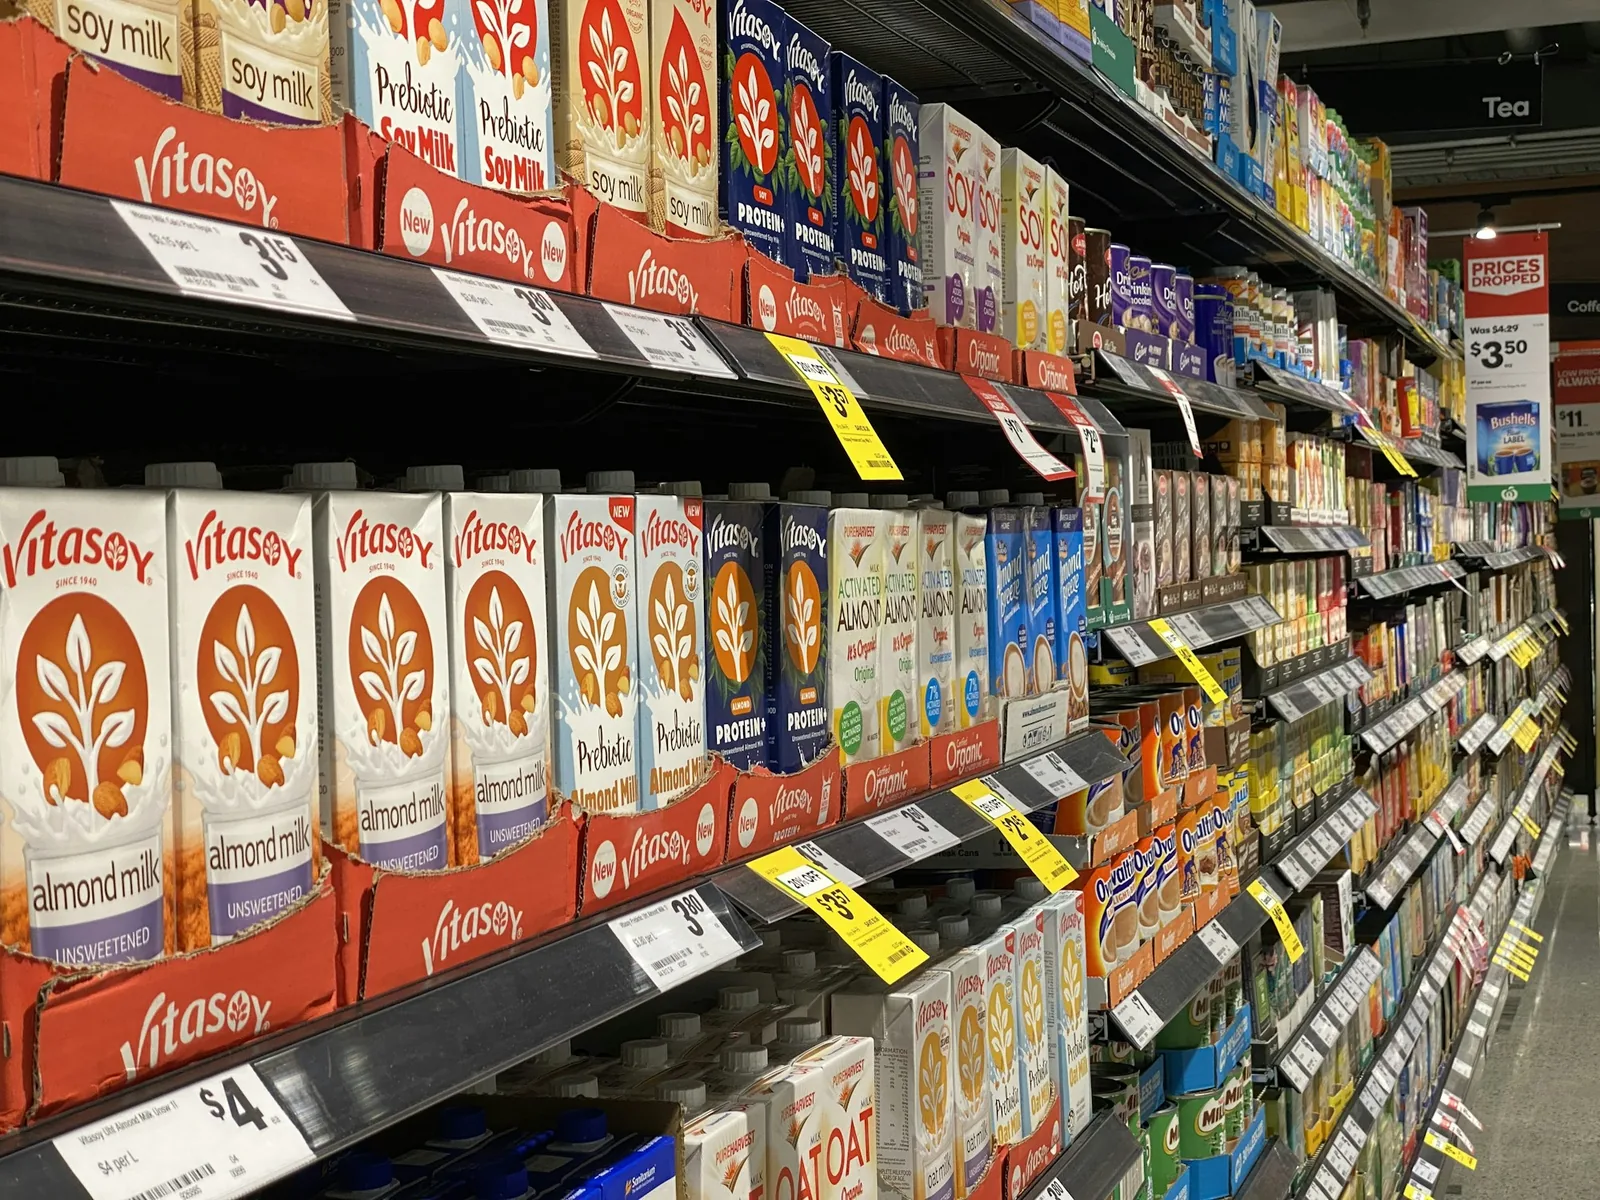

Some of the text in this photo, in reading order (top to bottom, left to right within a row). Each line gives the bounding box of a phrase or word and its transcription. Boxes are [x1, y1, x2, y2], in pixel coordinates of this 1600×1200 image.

[67, 4, 174, 64] soy milk
[231, 57, 314, 110] soy milk
[375, 61, 454, 123] Prebiotic
[1482, 96, 1530, 118] Tea
[479, 95, 545, 153] Prebiotic
[484, 146, 545, 192] Soy Milk
[592, 170, 643, 204] soy milk
[947, 166, 976, 222] SOY
[402, 208, 431, 236] New
[670, 196, 713, 229] soy milk
[543, 239, 565, 263] New
[1471, 258, 1541, 277] PRICES
[1471, 273, 1541, 288] DROPPED
[759, 298, 774, 318] New
[1470, 323, 1519, 335] Was $4.29
[969, 339, 999, 377] Organic
[1038, 360, 1069, 391] Organic
[1490, 411, 1537, 430] Bushells
[612, 505, 630, 518] NEW
[686, 505, 701, 517] NEW
[55, 575, 98, 589] SINCE 1940
[226, 569, 259, 582] SINCE 1940
[368, 562, 396, 574] SINCE 1940
[838, 576, 881, 599] ACTIVATED
[837, 599, 882, 632] ALMOND
[656, 708, 702, 754] Prebiotic
[577, 724, 632, 775] Prebiotic
[946, 733, 983, 774] Organic
[477, 759, 546, 803] almond milk
[650, 759, 690, 796] Almond
[864, 761, 909, 807] Organic
[361, 783, 444, 832] almond milk
[739, 815, 757, 832] New
[209, 816, 311, 871] almond milk
[489, 817, 541, 843] UNSWEETENED
[697, 821, 713, 842] New
[33, 848, 161, 912] almond milk
[594, 860, 614, 883] New
[227, 884, 303, 920] UNSWEETENED
[832, 1059, 865, 1086] PUREHARVEST
[199, 1075, 268, 1131] $4
[77, 1128, 105, 1146] Vitasoy
[114, 1114, 140, 1133] Almond
[139, 1110, 153, 1123] Milk
[153, 1103, 171, 1119] Unsw
[97, 1149, 139, 1177] $4 per L
[826, 1107, 873, 1186] OAT
[632, 1167, 656, 1188] Sanitarium
[775, 1143, 822, 1200] OAT
